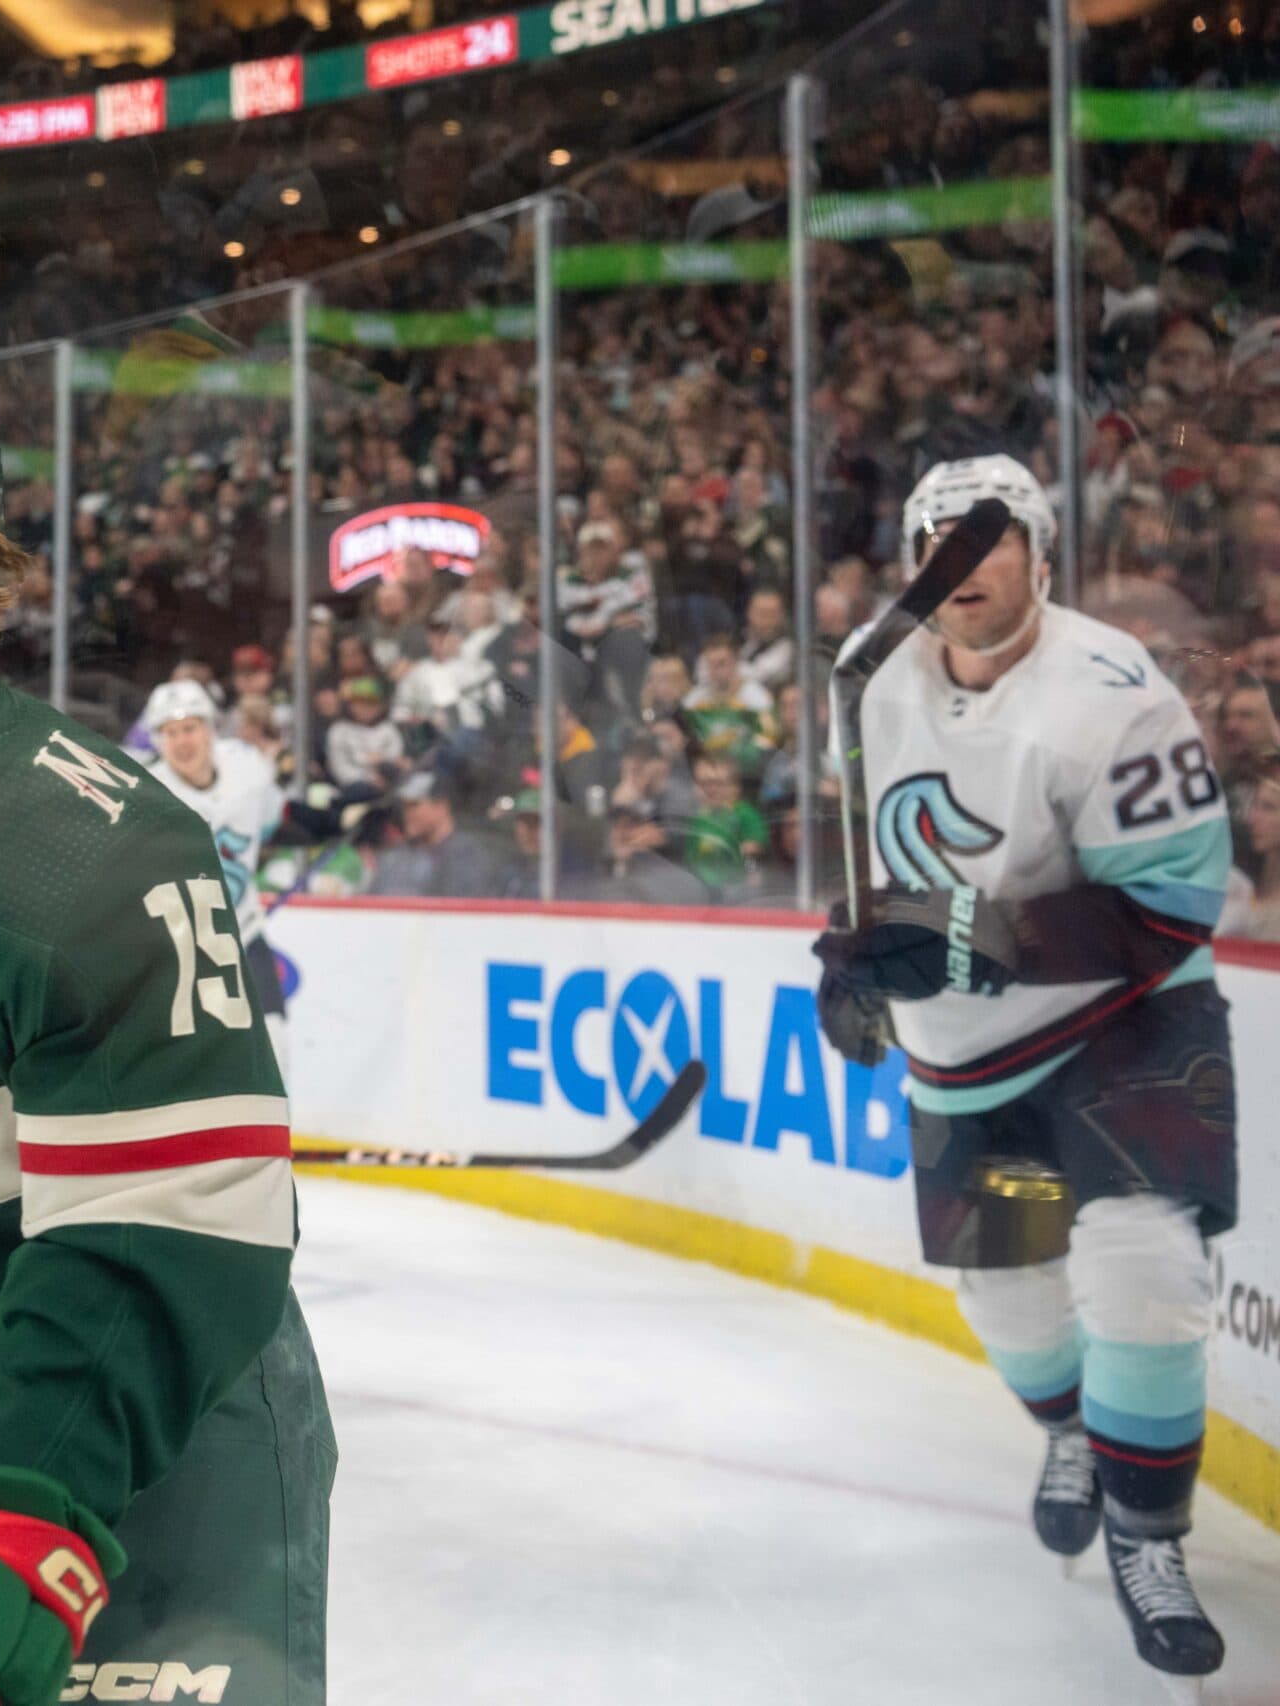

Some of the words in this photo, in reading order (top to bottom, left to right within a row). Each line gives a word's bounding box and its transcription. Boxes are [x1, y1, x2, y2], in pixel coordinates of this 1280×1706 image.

[463, 20, 511, 66] 24
[551, 0, 765, 54] SEAT
[1110, 738, 1220, 832] 28
[142, 878, 253, 1037] 15
